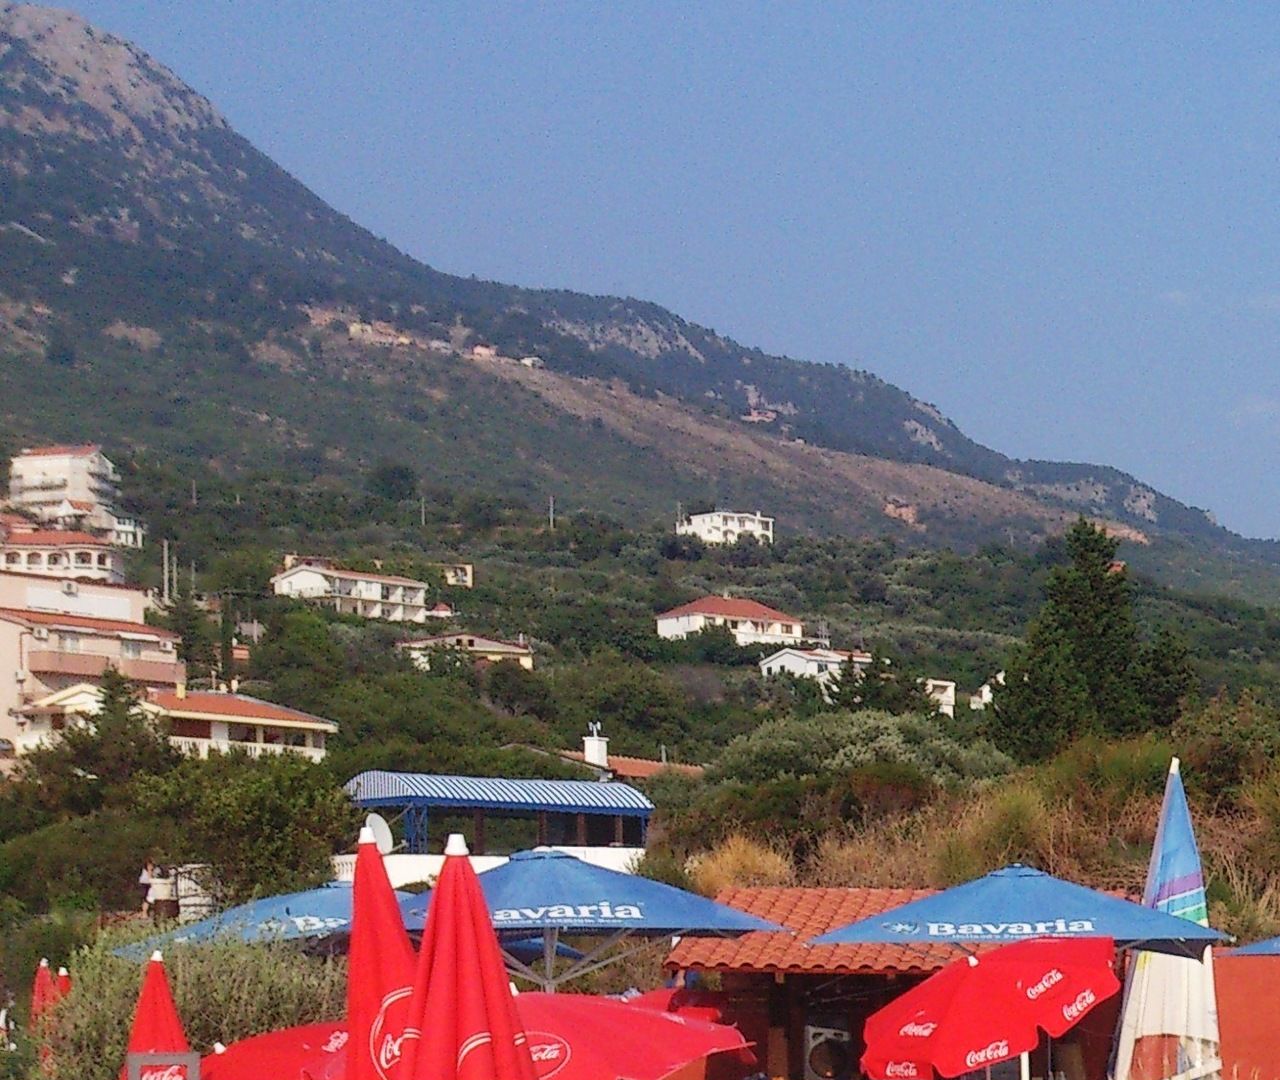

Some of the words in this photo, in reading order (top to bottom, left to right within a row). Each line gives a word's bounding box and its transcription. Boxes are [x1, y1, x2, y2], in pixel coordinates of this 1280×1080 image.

[493, 901, 645, 920] avaria
[927, 918, 1096, 936] Bavaria
[966, 1039, 1009, 1067] Coca-Cola
